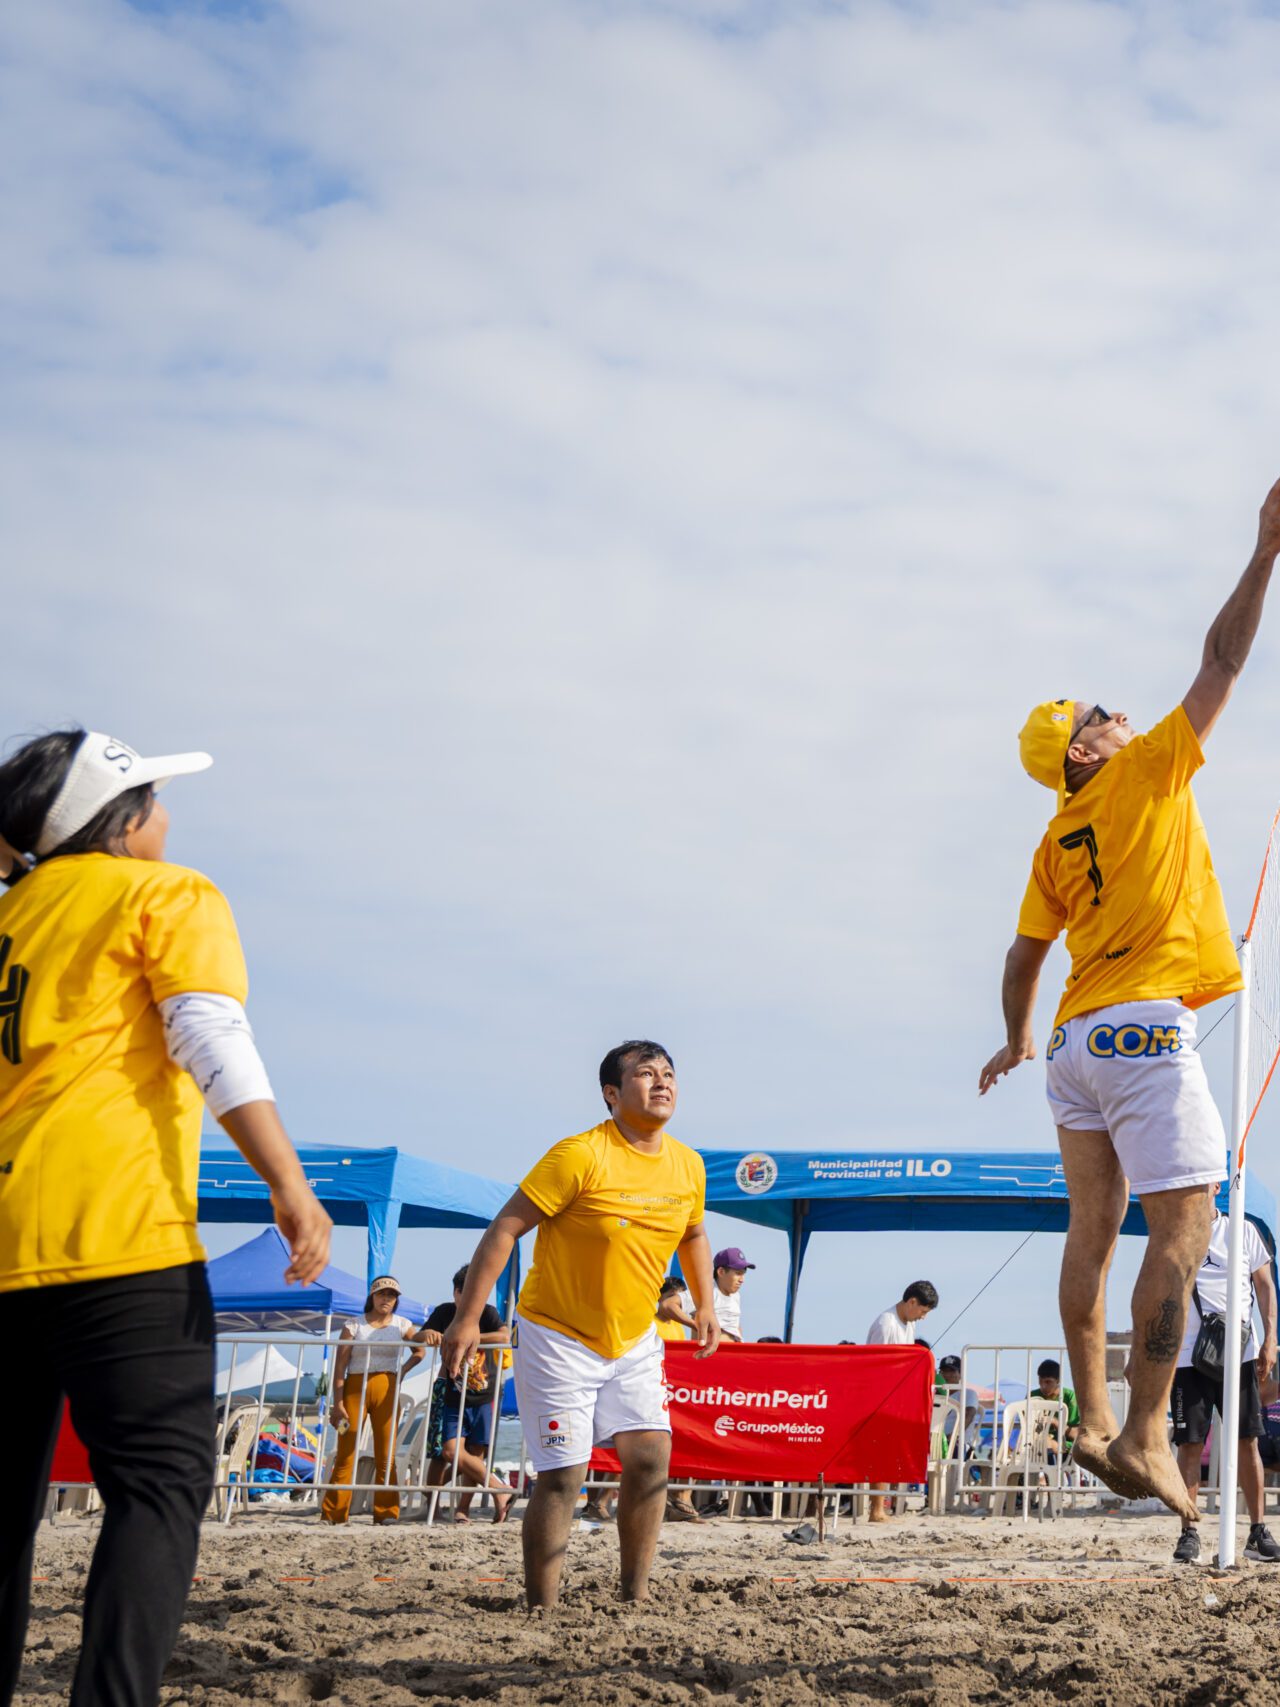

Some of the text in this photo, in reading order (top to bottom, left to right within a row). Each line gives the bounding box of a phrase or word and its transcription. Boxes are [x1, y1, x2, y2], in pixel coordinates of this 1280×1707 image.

[1058, 822, 1103, 906] 7
[808, 1160, 903, 1169] Municipalidad
[906, 1159, 952, 1177] ILO
[814, 1169, 902, 1179] Provincial de
[736, 1421, 825, 1435] GrupoMéxico
[546, 1436, 565, 1445] JPN
